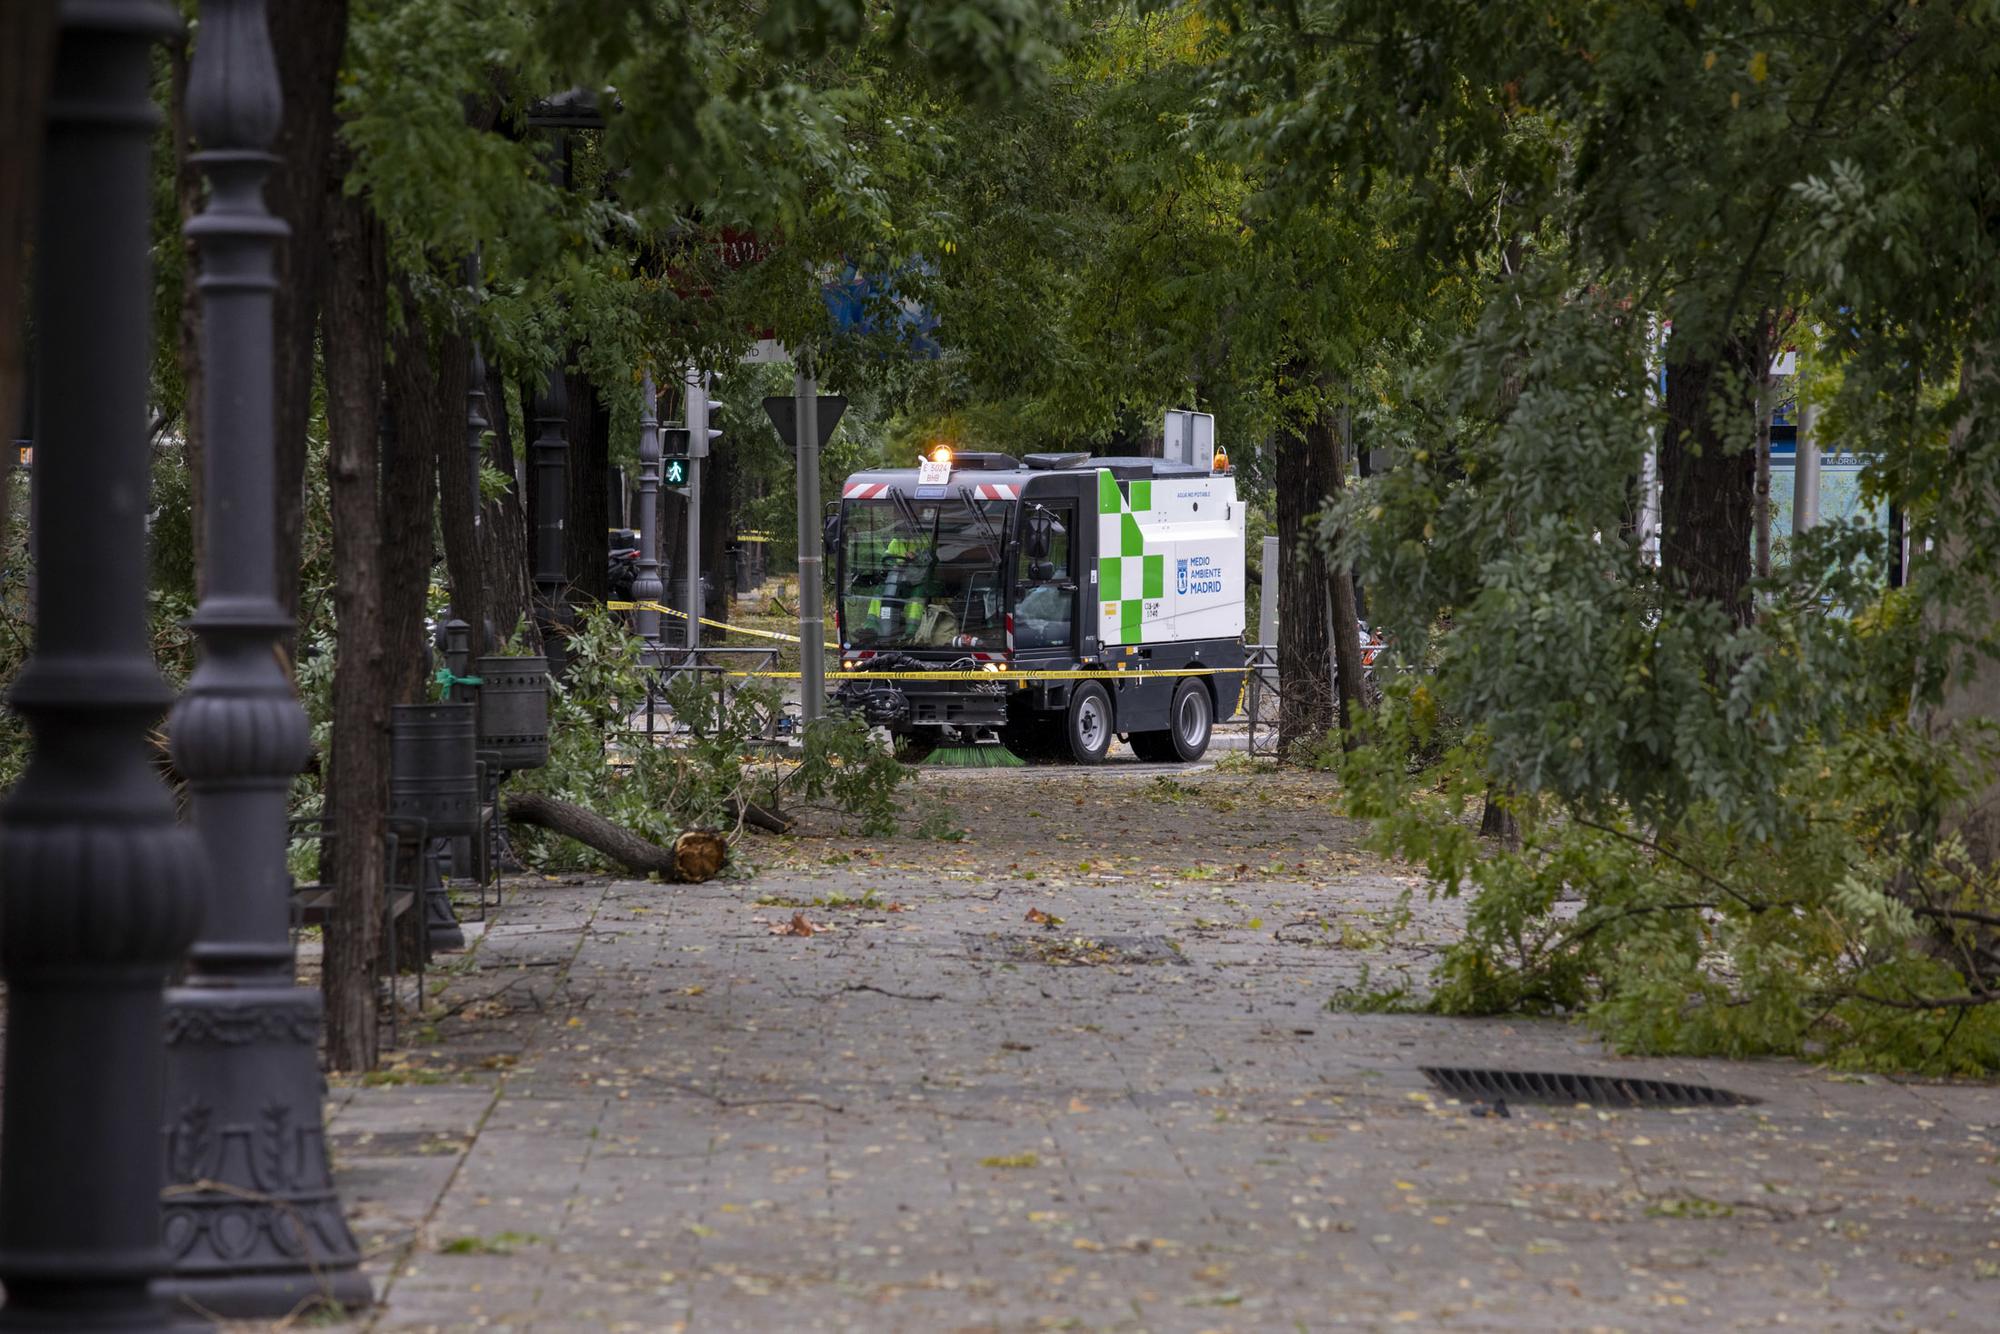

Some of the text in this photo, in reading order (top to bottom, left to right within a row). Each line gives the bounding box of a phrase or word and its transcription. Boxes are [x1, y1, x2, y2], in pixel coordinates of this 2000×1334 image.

[1190, 556, 1210, 566] MEDIO
[1190, 568, 1221, 578] AMBIENTE
[1190, 581, 1221, 594] MADRID
